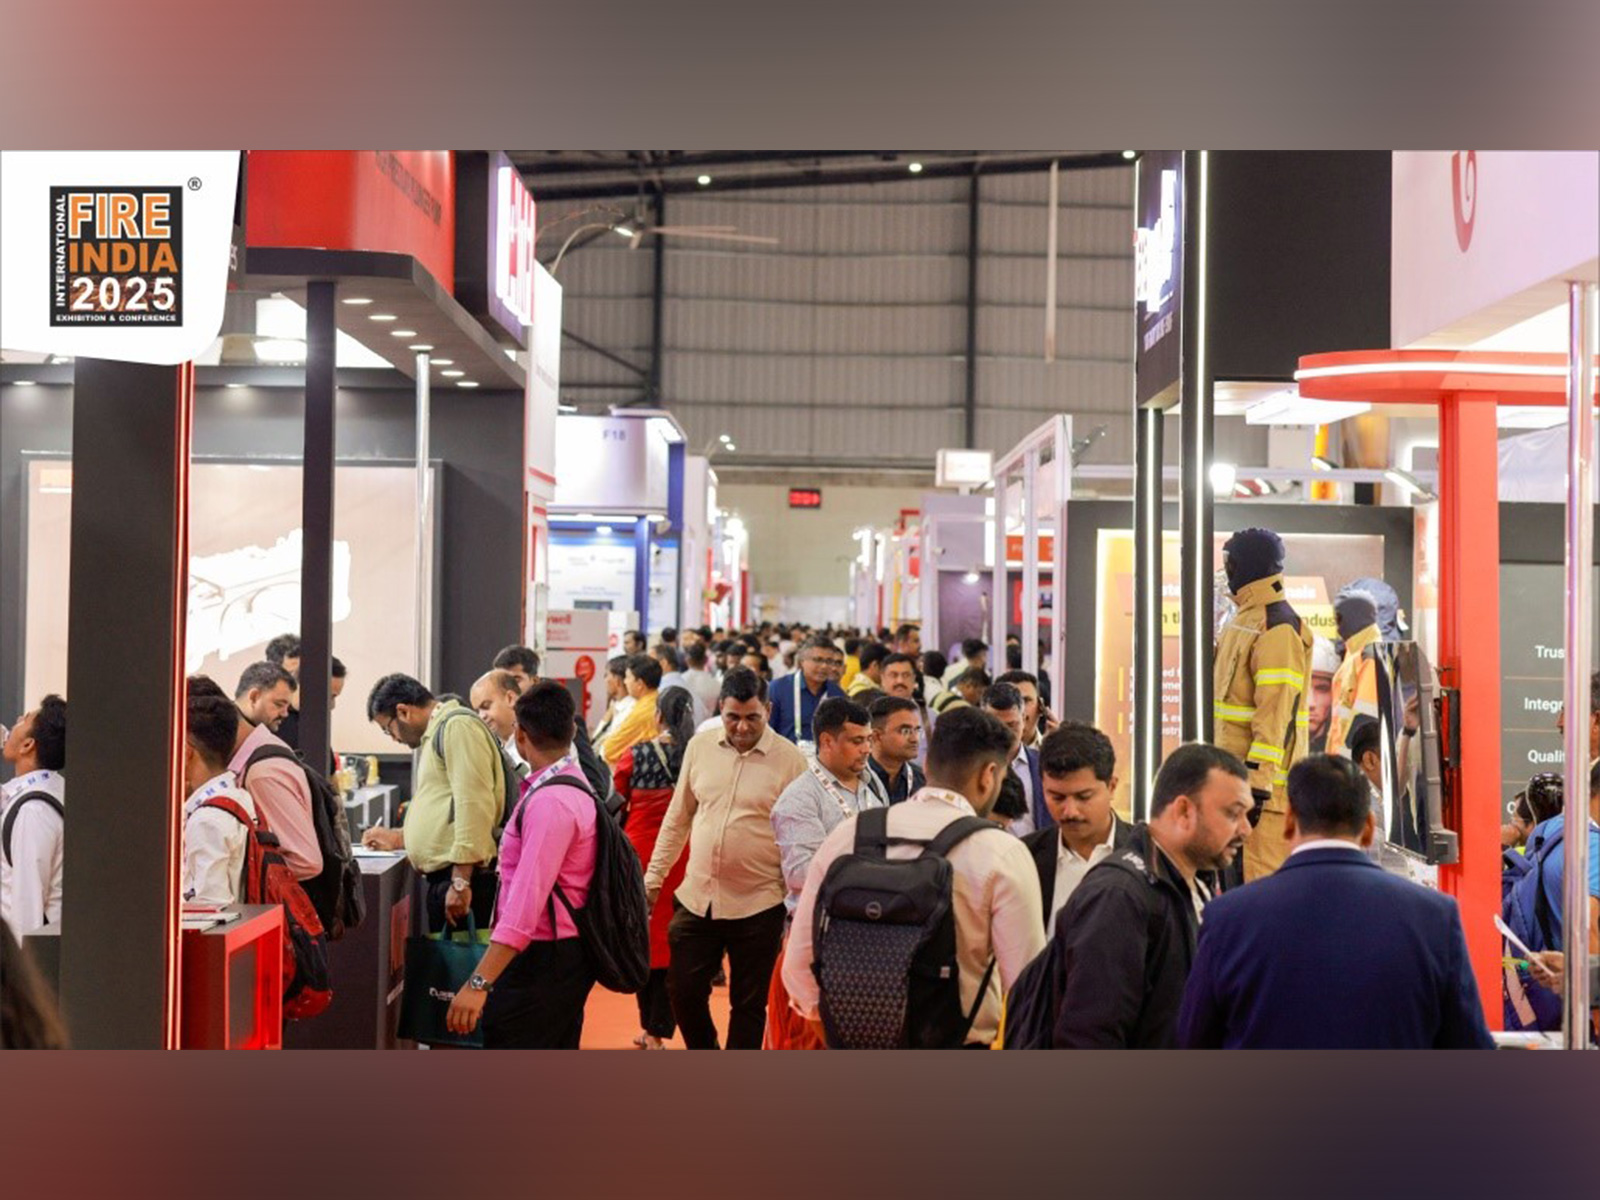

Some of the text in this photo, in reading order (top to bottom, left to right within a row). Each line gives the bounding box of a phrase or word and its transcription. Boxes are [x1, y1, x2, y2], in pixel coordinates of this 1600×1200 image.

[1534, 645, 1566, 659] Trus
[1524, 697, 1564, 714] Integr
[1527, 749, 1566, 764] Quali
